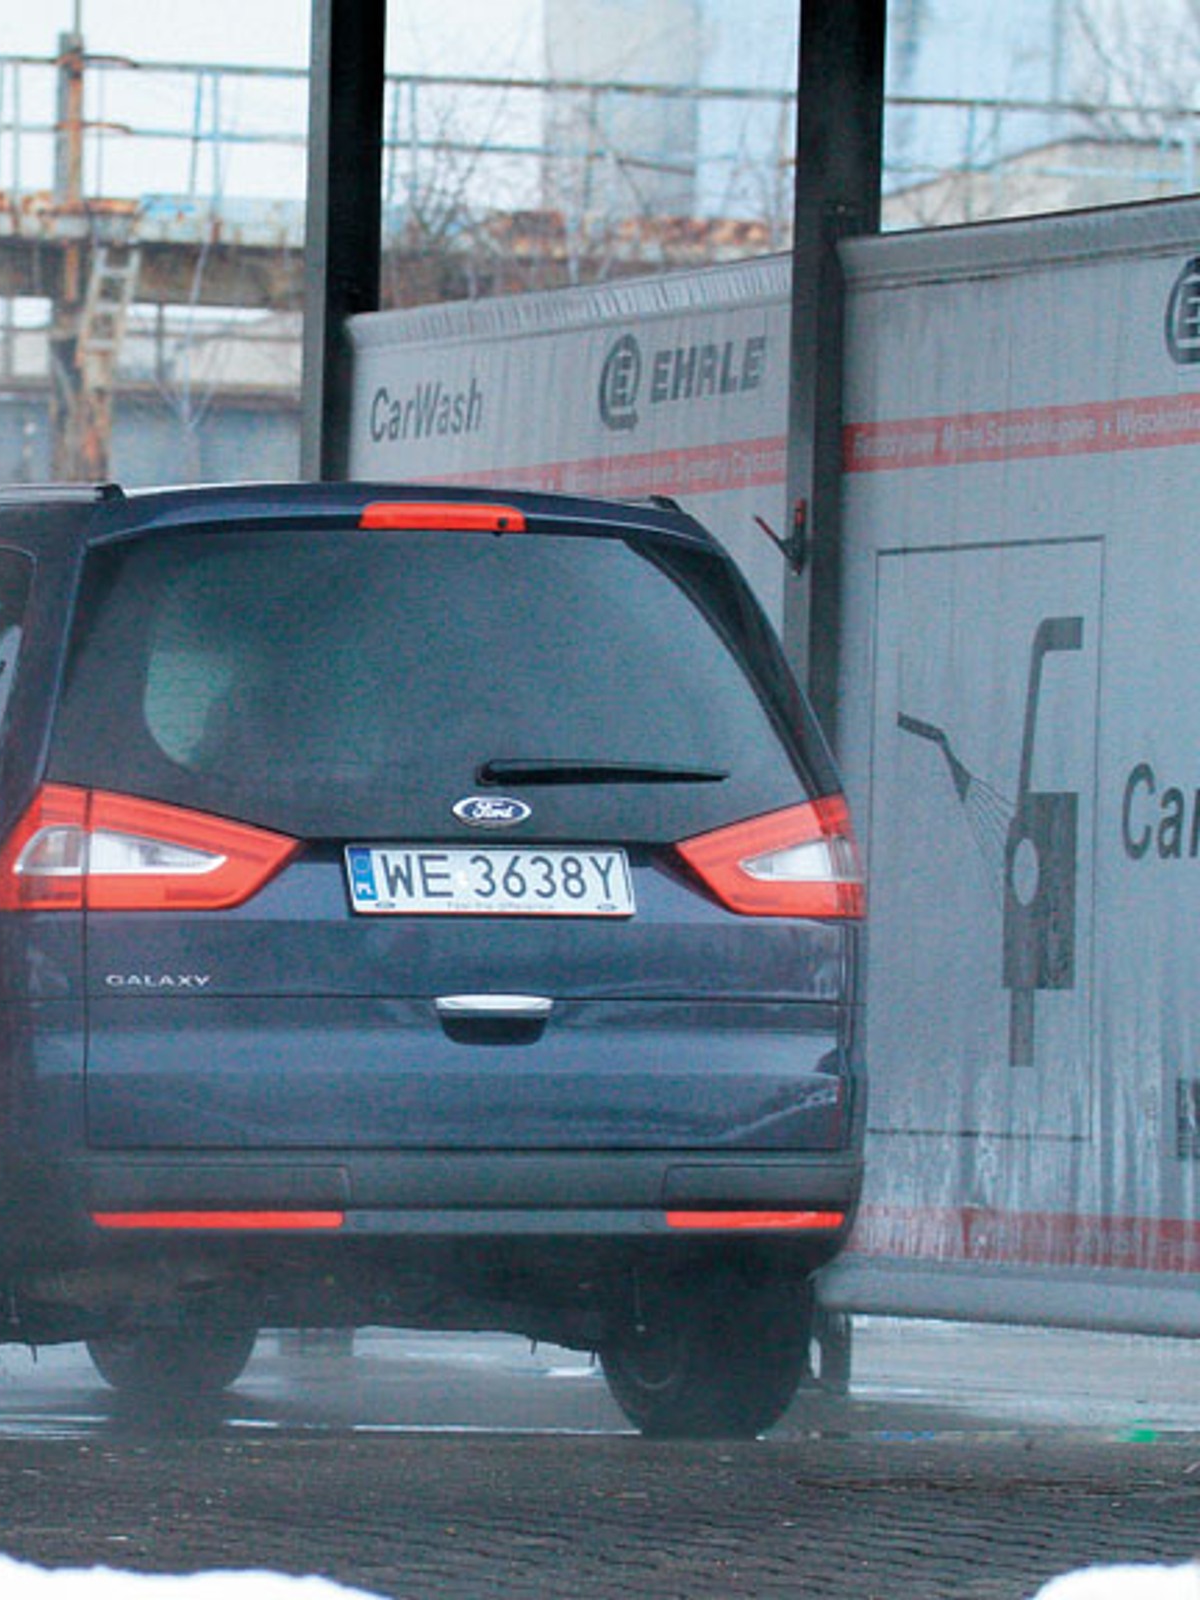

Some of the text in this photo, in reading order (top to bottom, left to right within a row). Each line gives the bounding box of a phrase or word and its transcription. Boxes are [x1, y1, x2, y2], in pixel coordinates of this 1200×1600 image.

[651, 336, 766, 404] EHRLE
[369, 378, 483, 443] CarWash
[381, 854, 615, 900] WE 3638Y
[105, 974, 211, 988] GALAXY
